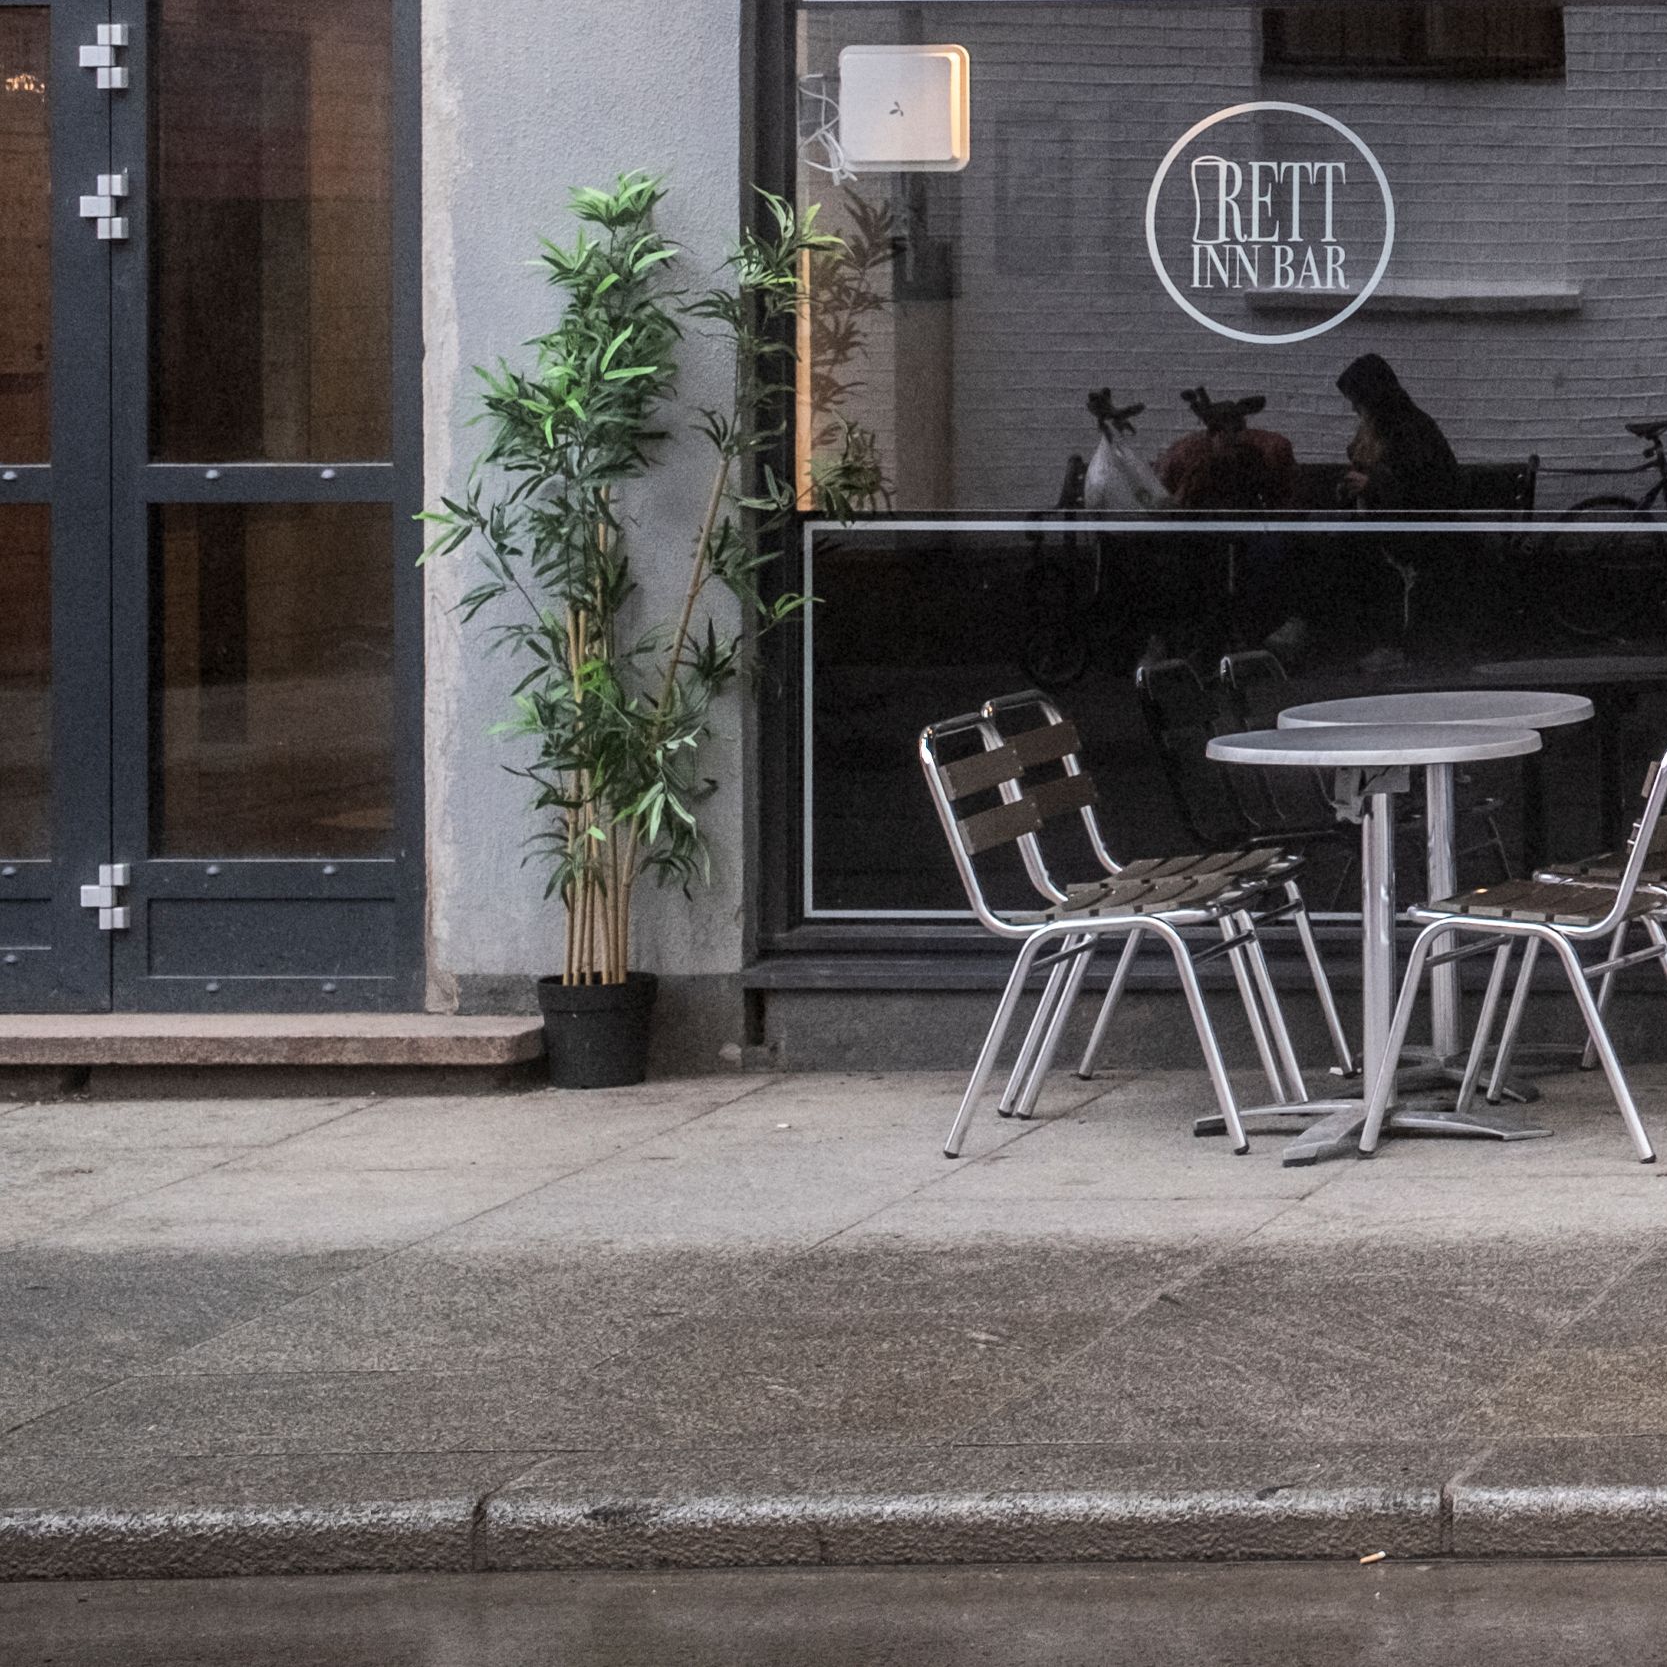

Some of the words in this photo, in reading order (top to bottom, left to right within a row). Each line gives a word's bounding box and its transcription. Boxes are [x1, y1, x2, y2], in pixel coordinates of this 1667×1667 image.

[1191, 155, 1346, 244] RETT
[1190, 244, 1261, 288] INN
[1271, 244, 1350, 289] BAR
